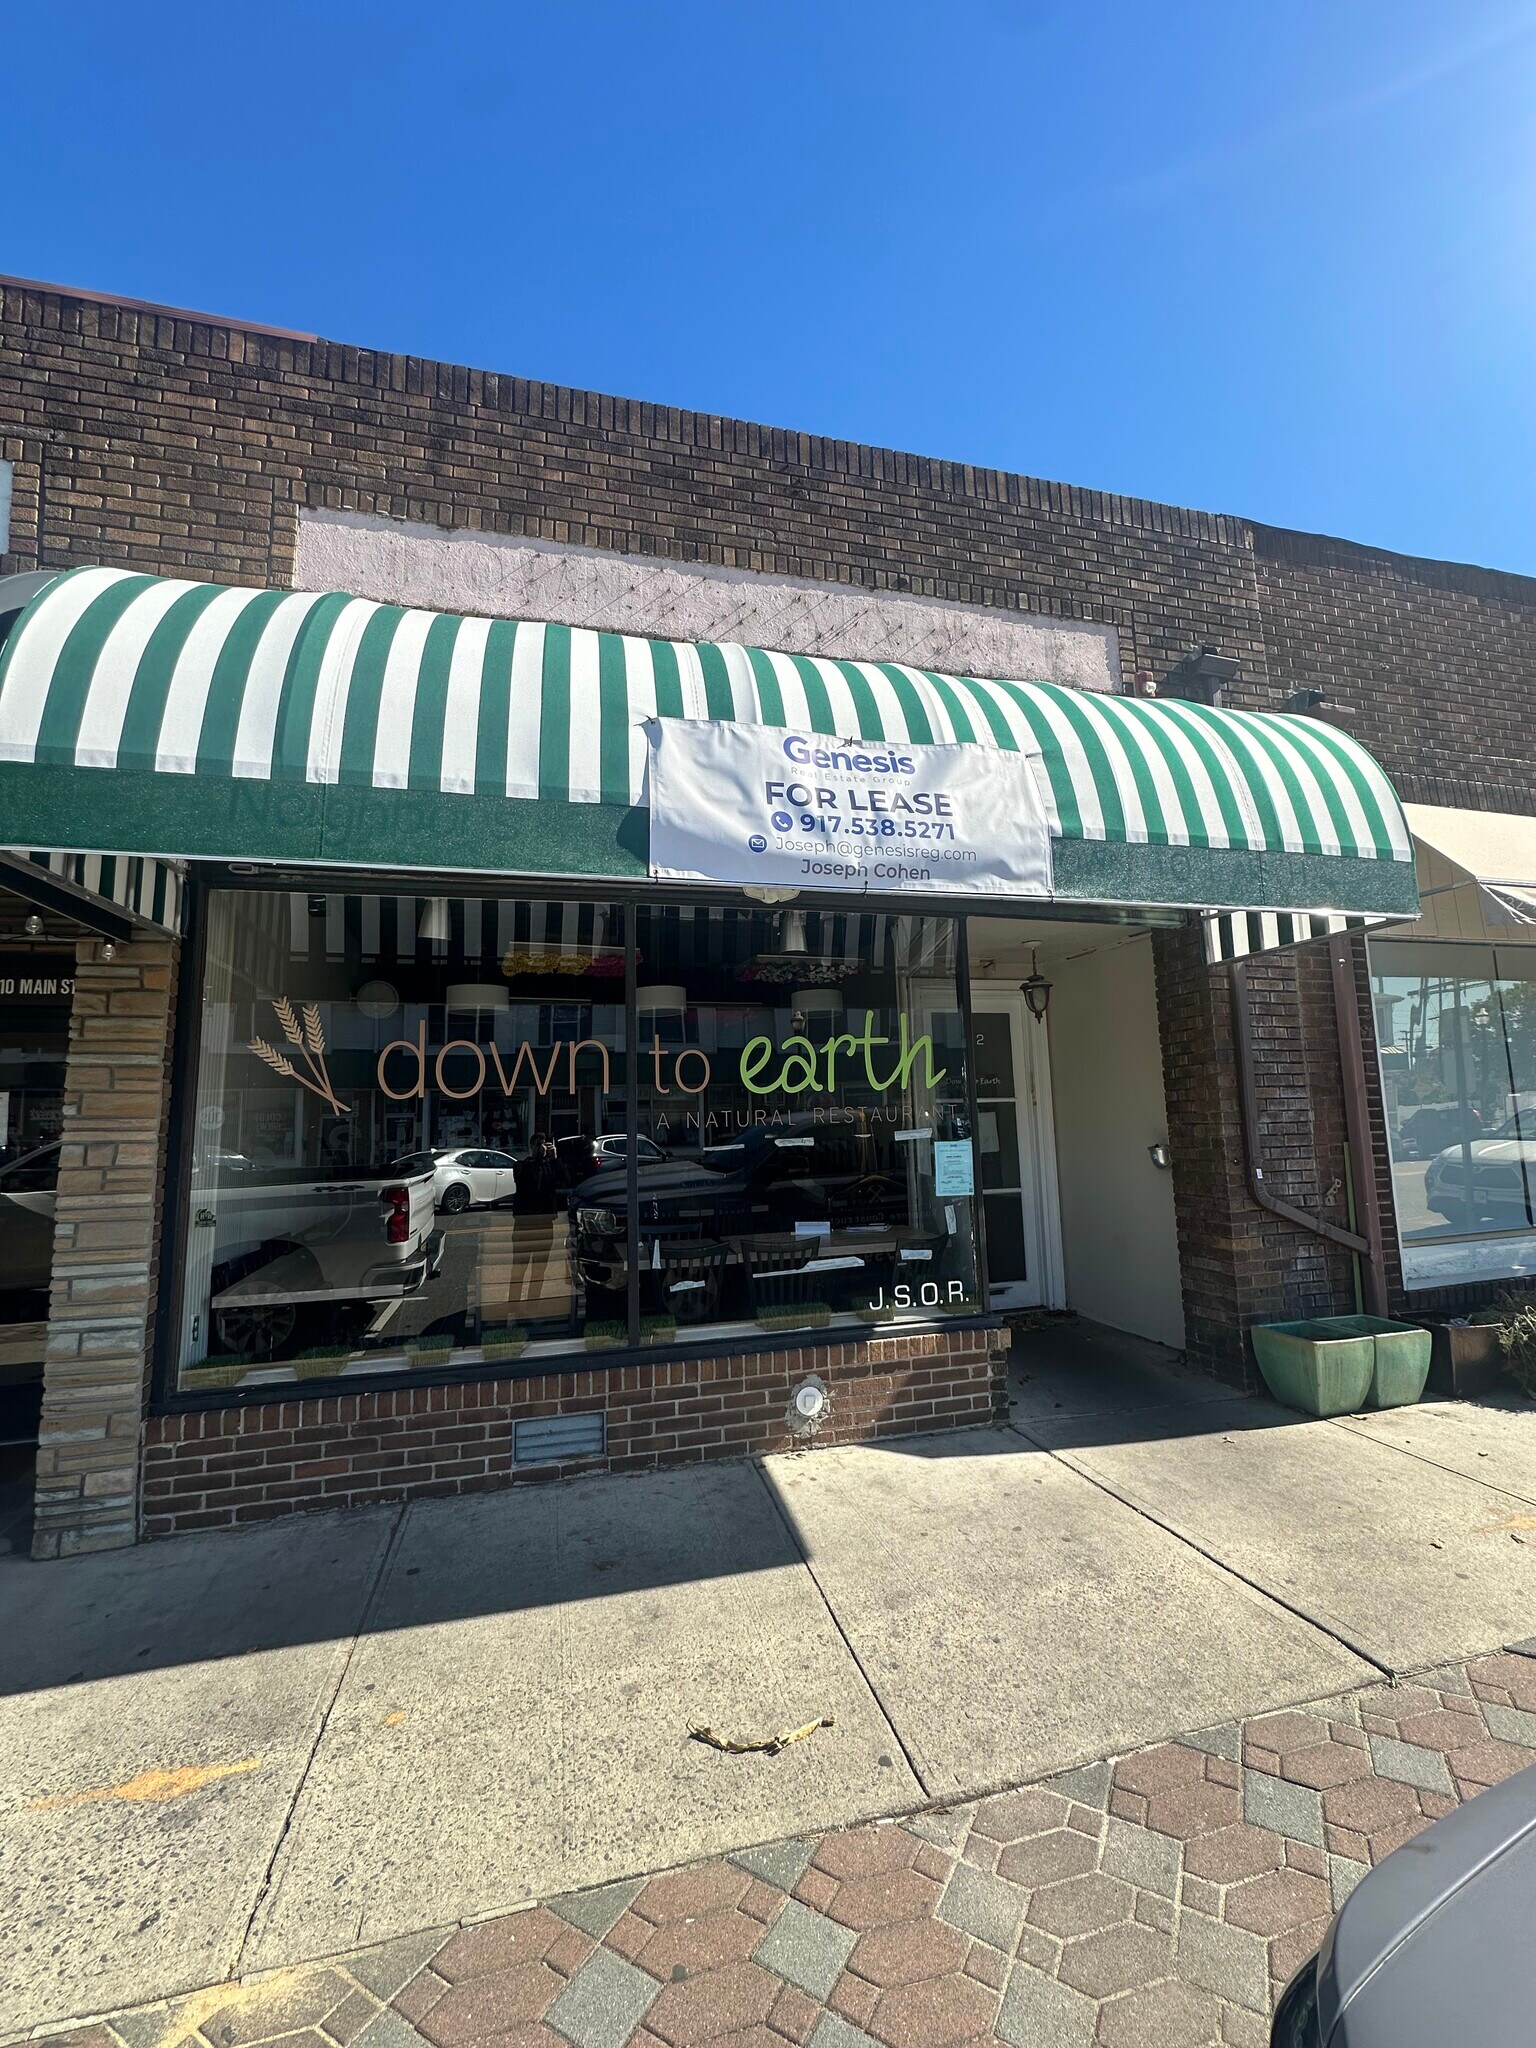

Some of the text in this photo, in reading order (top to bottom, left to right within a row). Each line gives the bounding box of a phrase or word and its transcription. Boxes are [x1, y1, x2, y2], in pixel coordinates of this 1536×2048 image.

[782, 735, 916, 775] Genesis
[791, 766, 911, 787] Real Estate Group
[765, 781, 954, 817] FOR LEASE
[800, 813, 956, 841] 917.538.5271
[775, 836, 977, 863] Joseph@genesisreg.com
[800, 858, 931, 880] Joseph Cohen
[19, 978, 57, 995] MAIN
[377, 1009, 947, 1100] down to earth
[656, 1103, 958, 1130] A NATURAL RESTAURANT
[869, 1280, 970, 1311] J.S.O.R.
